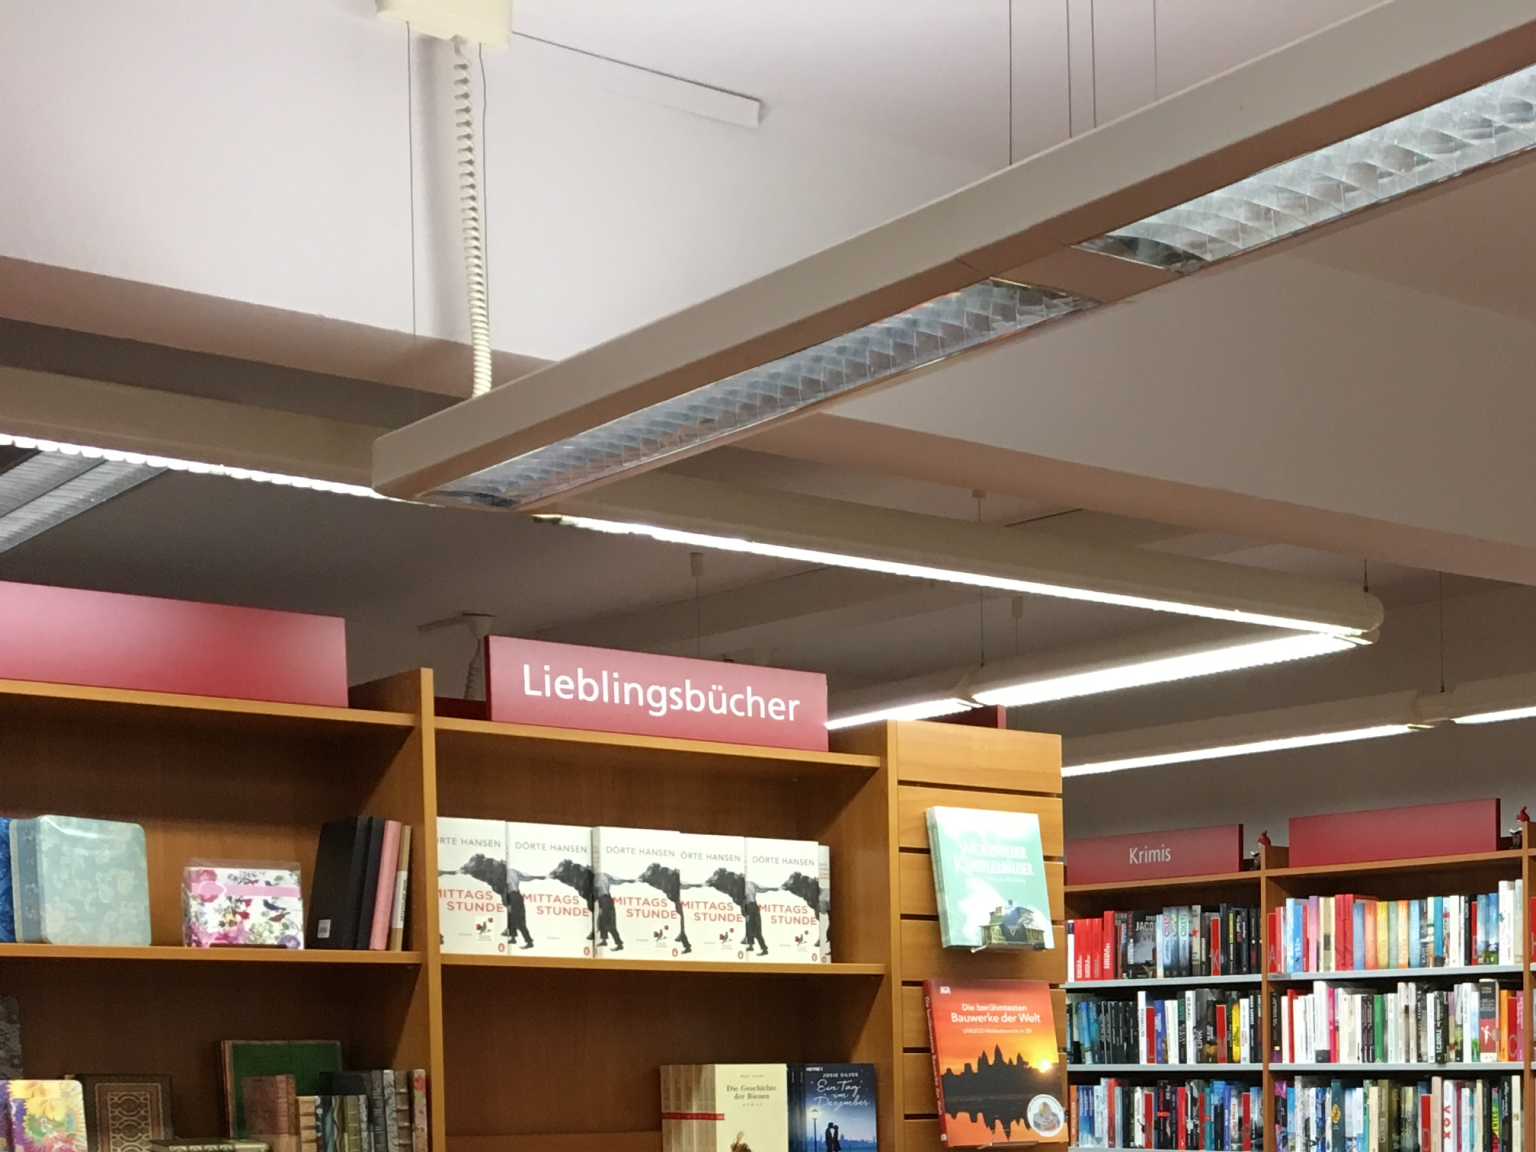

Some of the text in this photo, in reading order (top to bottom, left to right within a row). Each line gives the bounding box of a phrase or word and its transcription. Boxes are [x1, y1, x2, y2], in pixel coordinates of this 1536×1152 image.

[523, 663, 800, 721] Lieblingsbücher
[461, 839, 501, 847] HANSEN
[515, 841, 587, 854] DÖRTE HANSEN
[606, 846, 675, 857] DÖRTE HANSEN
[1129, 844, 1171, 864] Krimis
[706, 853, 741, 862] HANSEN
[752, 856, 815, 866] DÖRTE HANSEN
[522, 893, 580, 904] MITTAGS
[612, 897, 668, 908] MITTAGS
[447, 901, 505, 913] STUNDE
[536, 906, 590, 917] STUNDE
[681, 901, 734, 911] MITTAGS
[759, 904, 808, 914] MITTAGS
[626, 908, 678, 920] STUNDE
[694, 912, 743, 923] STUNDE
[770, 915, 817, 926] STUNDE
[962, 1003, 1027, 1012] Die berühmtesten
[951, 1013, 1041, 1023] Bauwerke der Welt
[726, 1084, 777, 1093] Die Geschichte
[816, 1079, 861, 1098] Ein Tag
